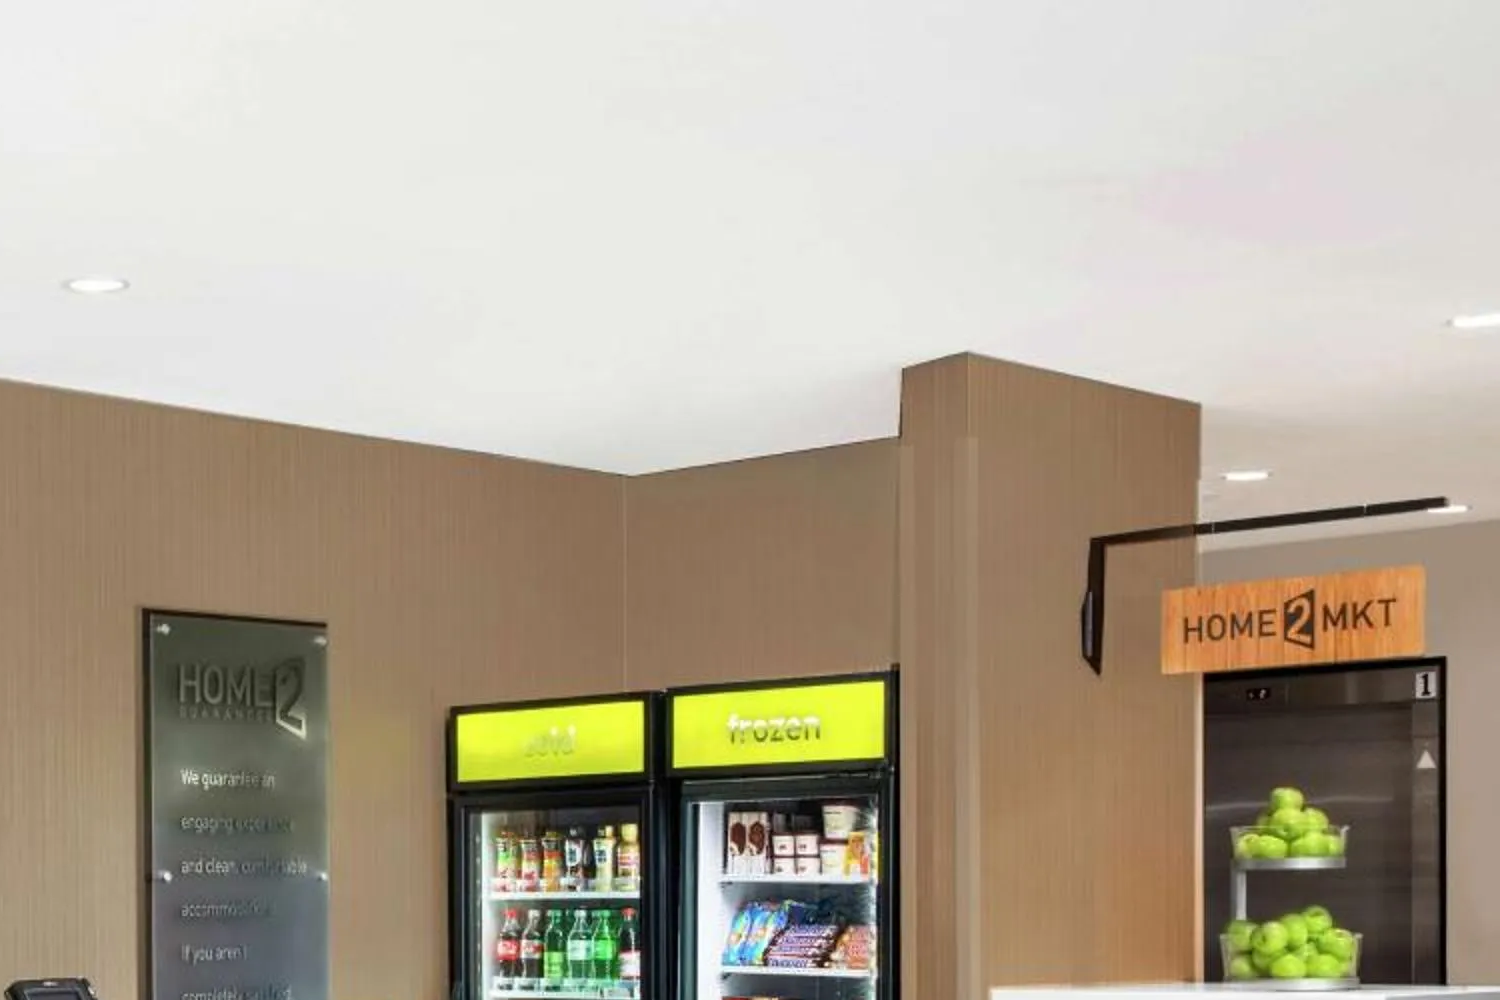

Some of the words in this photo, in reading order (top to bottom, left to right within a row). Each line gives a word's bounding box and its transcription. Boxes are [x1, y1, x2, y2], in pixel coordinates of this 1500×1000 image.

[1183, 608, 1277, 645] HOME
[1322, 598, 1397, 633] MKT
[1420, 673, 1432, 697] 1
[726, 713, 821, 745] frozen
[180, 768, 200, 785] We
[181, 858, 203, 874] and
[191, 948, 213, 966] you
